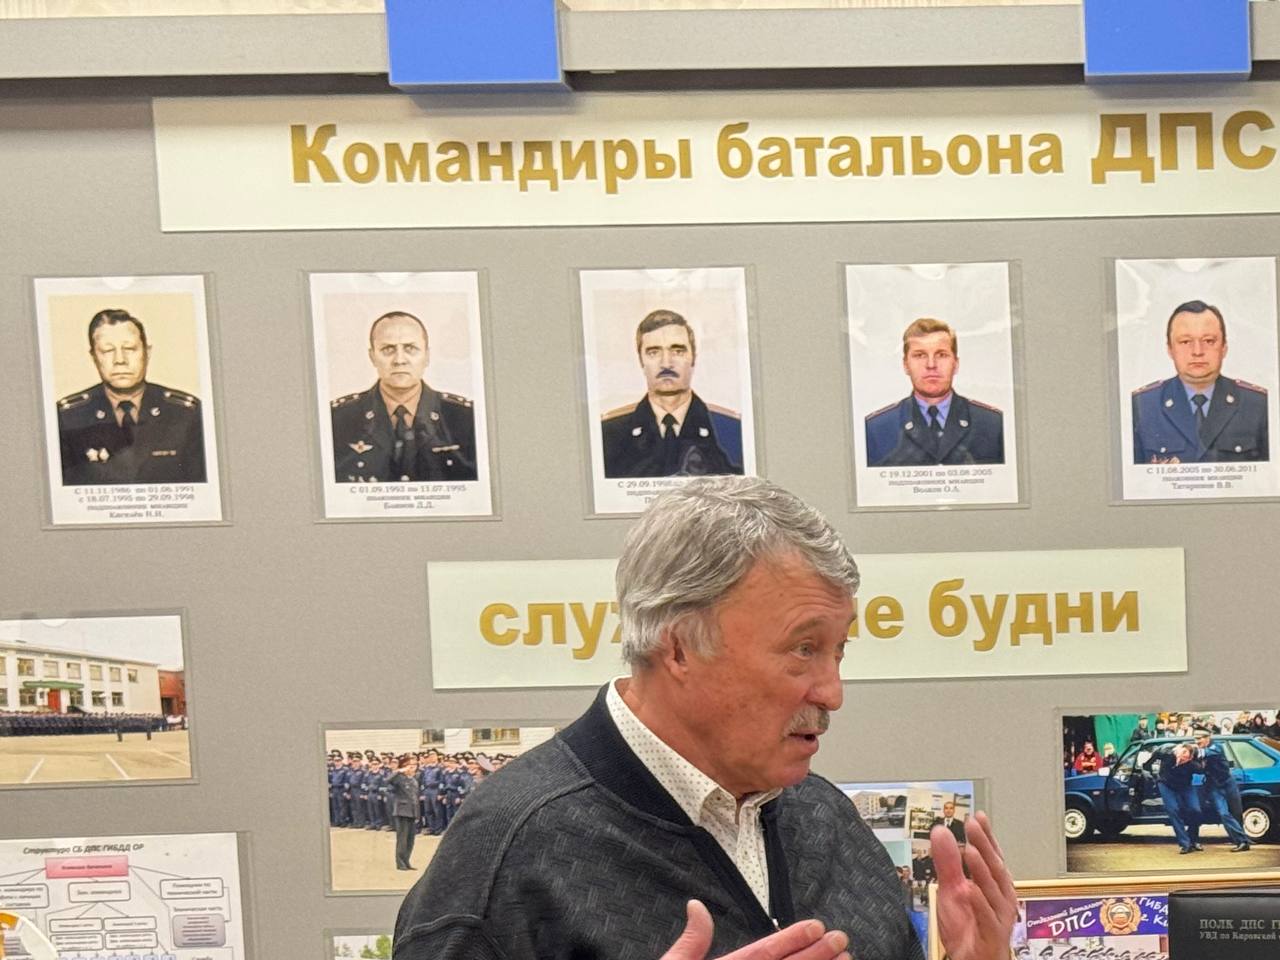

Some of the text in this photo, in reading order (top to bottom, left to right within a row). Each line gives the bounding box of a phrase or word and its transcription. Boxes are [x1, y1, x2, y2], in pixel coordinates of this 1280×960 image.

[290, 110, 1277, 194] Командиры батальона ДПС
[928, 579, 1140, 651] будни
[1048, 911, 1096, 936] ДПС
[1200, 919, 1234, 930] ПОЛК
[1240, 919, 1265, 930] ДПС
[1232, 931, 1276, 941] Кировской
